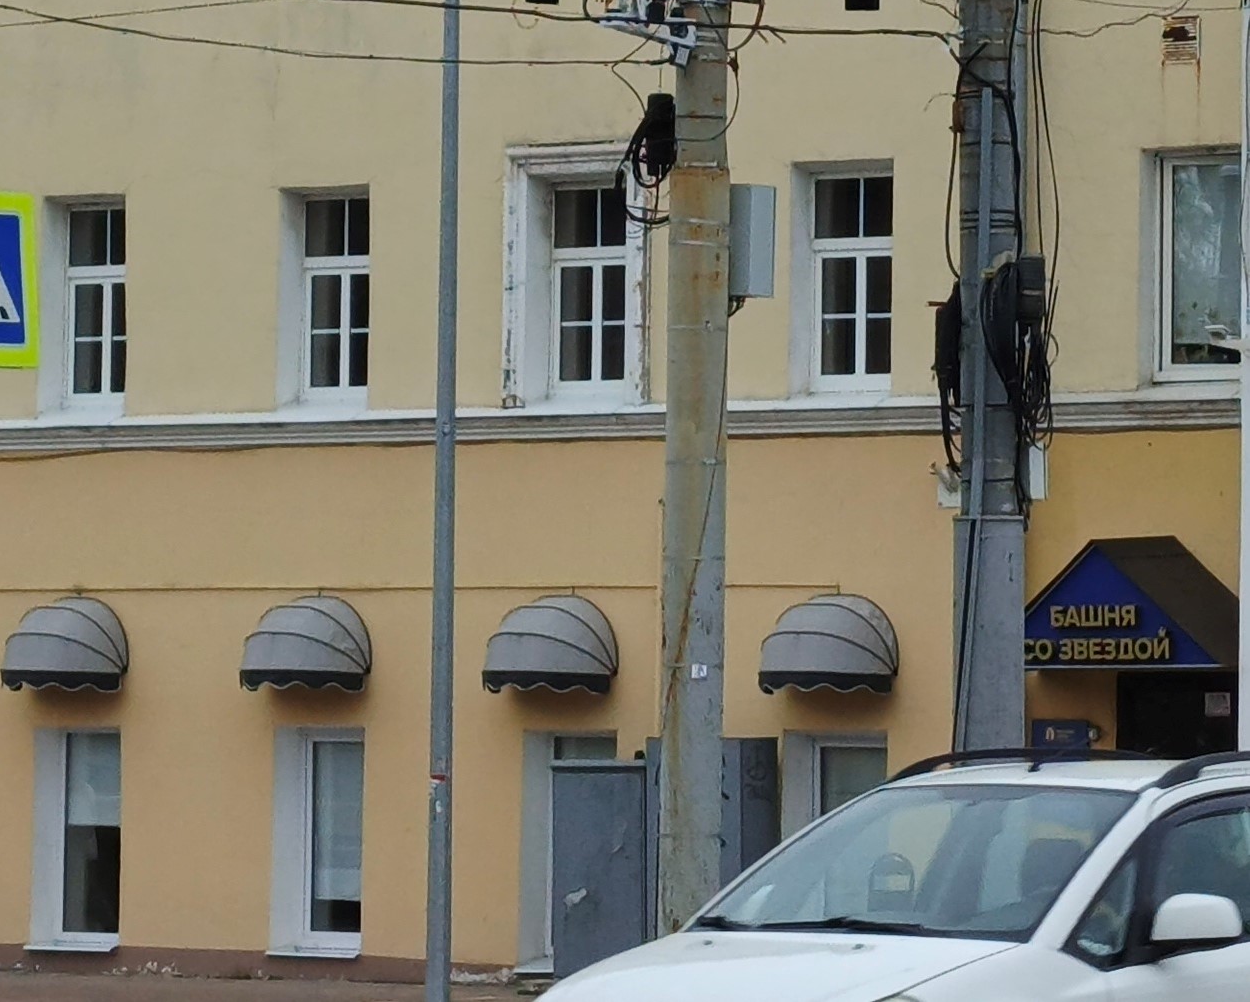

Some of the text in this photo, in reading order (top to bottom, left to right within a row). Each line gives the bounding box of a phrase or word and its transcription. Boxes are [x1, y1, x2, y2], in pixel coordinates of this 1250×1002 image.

[1050, 604, 1136, 627] БАШНЯ
[1024, 626, 1170, 660] СО ЗВЕЗДОЙ
